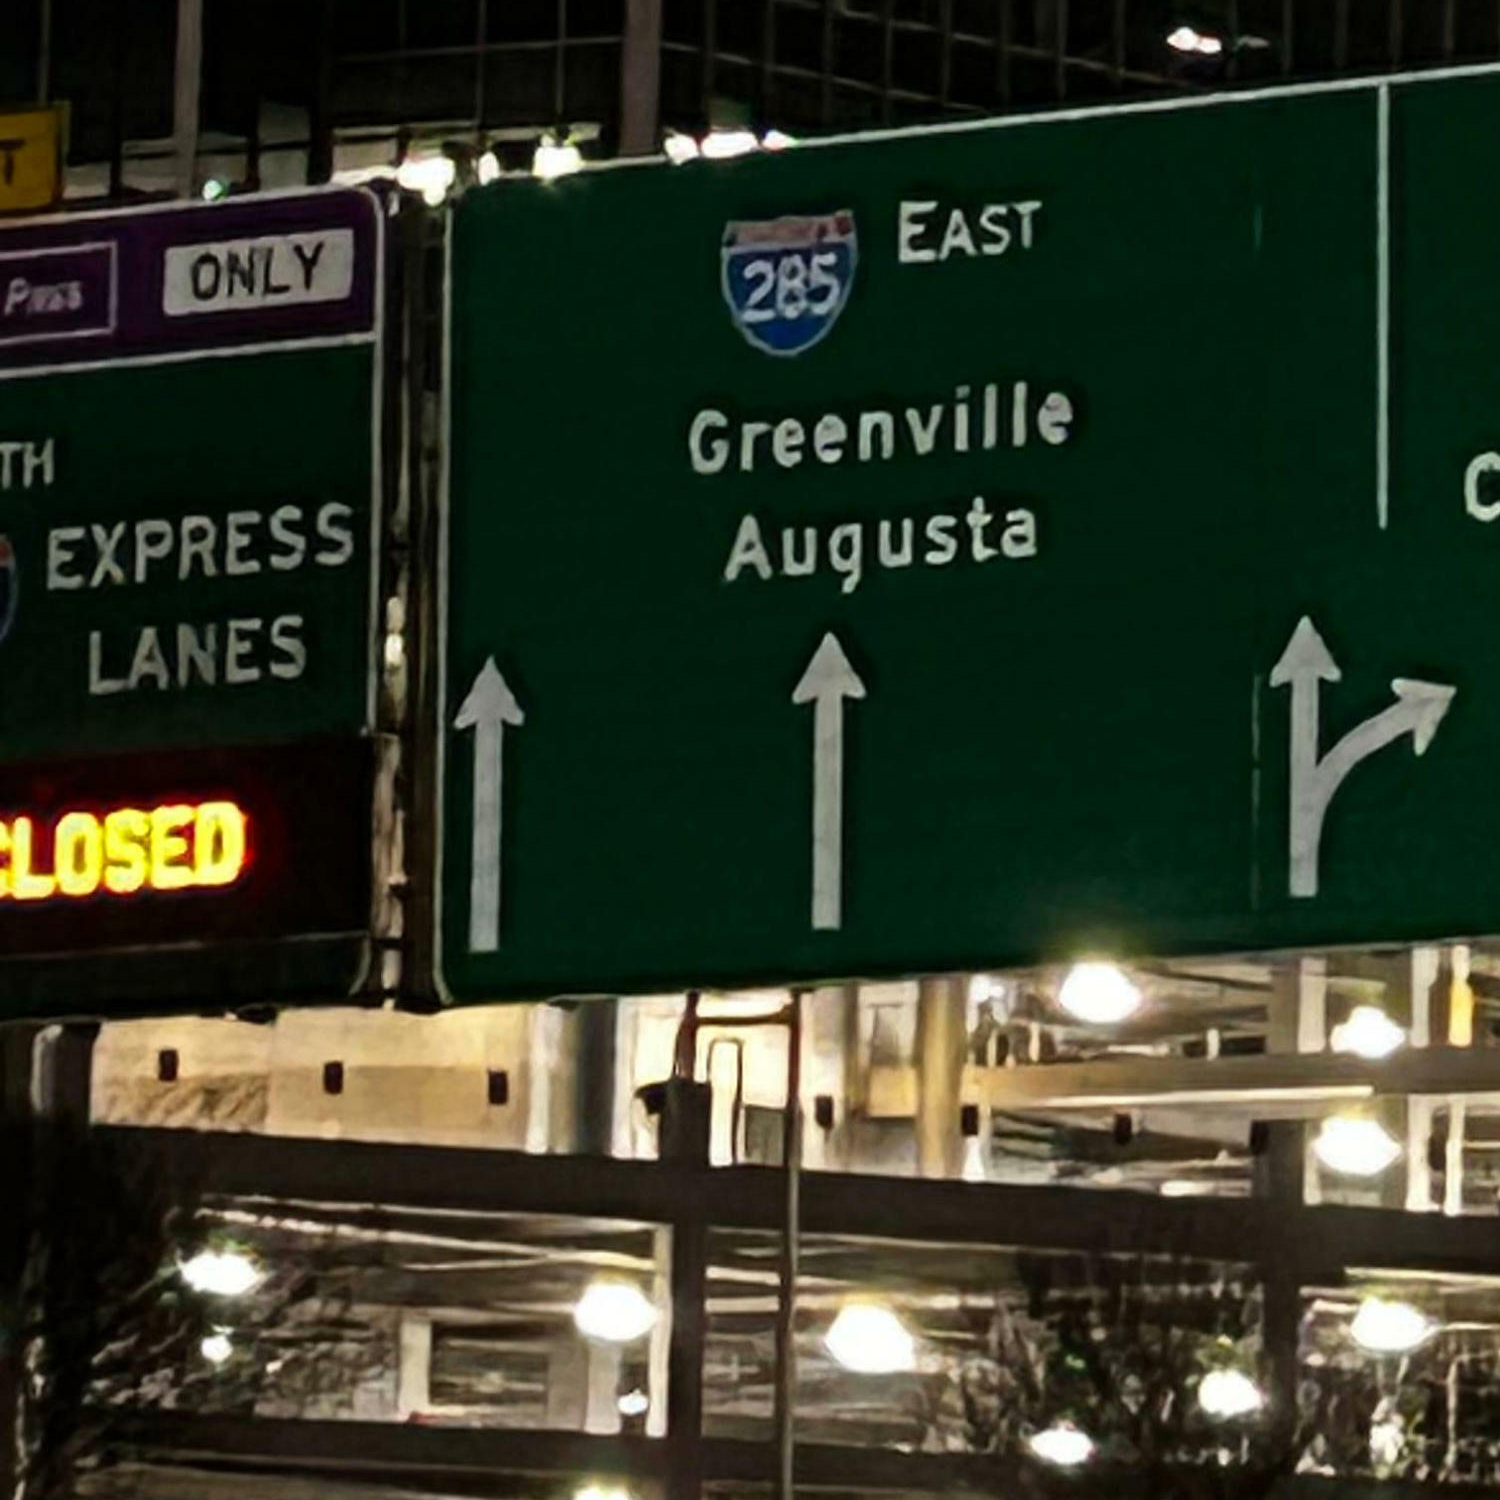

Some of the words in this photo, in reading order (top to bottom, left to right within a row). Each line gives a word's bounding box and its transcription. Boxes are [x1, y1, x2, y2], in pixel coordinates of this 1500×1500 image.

[190, 241, 325, 301] ONLY
[740, 252, 841, 323] 285
[898, 200, 1043, 263] EAST
[688, 380, 1074, 474] Greenville
[47, 502, 355, 591] EXPRESS
[722, 496, 1038, 595] Augusta
[89, 614, 307, 695] LANES
[0, 801, 246, 900] LOSED
